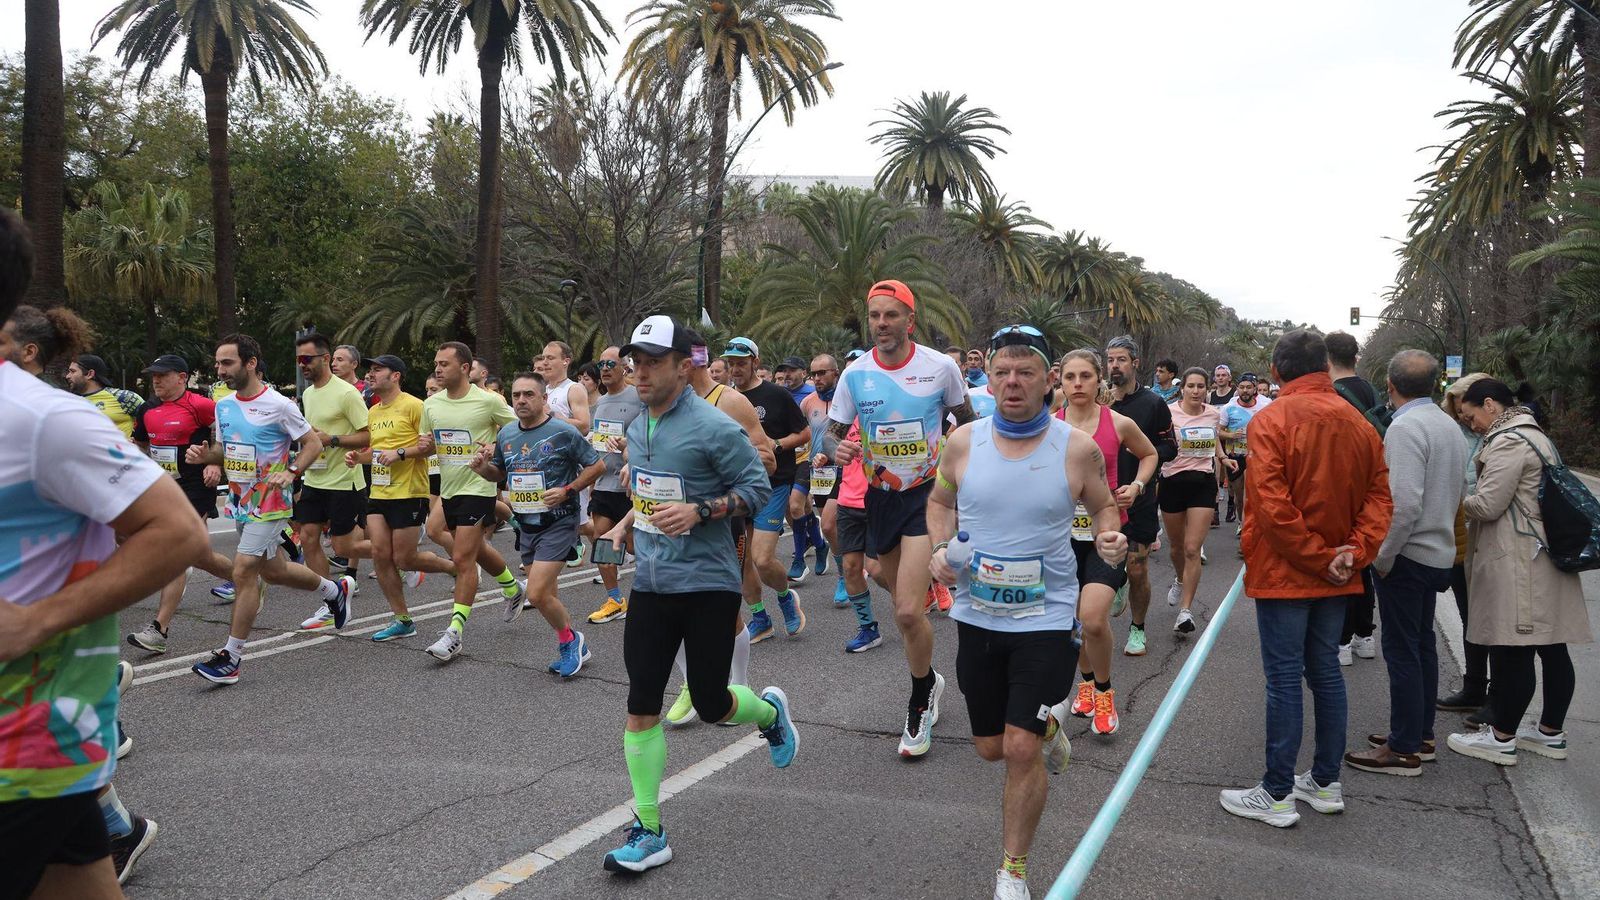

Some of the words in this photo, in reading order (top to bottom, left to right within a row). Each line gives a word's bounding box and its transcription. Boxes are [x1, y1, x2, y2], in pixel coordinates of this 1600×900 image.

[446, 445, 463, 455] 939
[883, 443, 918, 457] 1039
[1189, 440, 1212, 449] 3280
[226, 460, 249, 472] 2334
[514, 491, 540, 503] 2083
[989, 587, 1027, 604] 760
